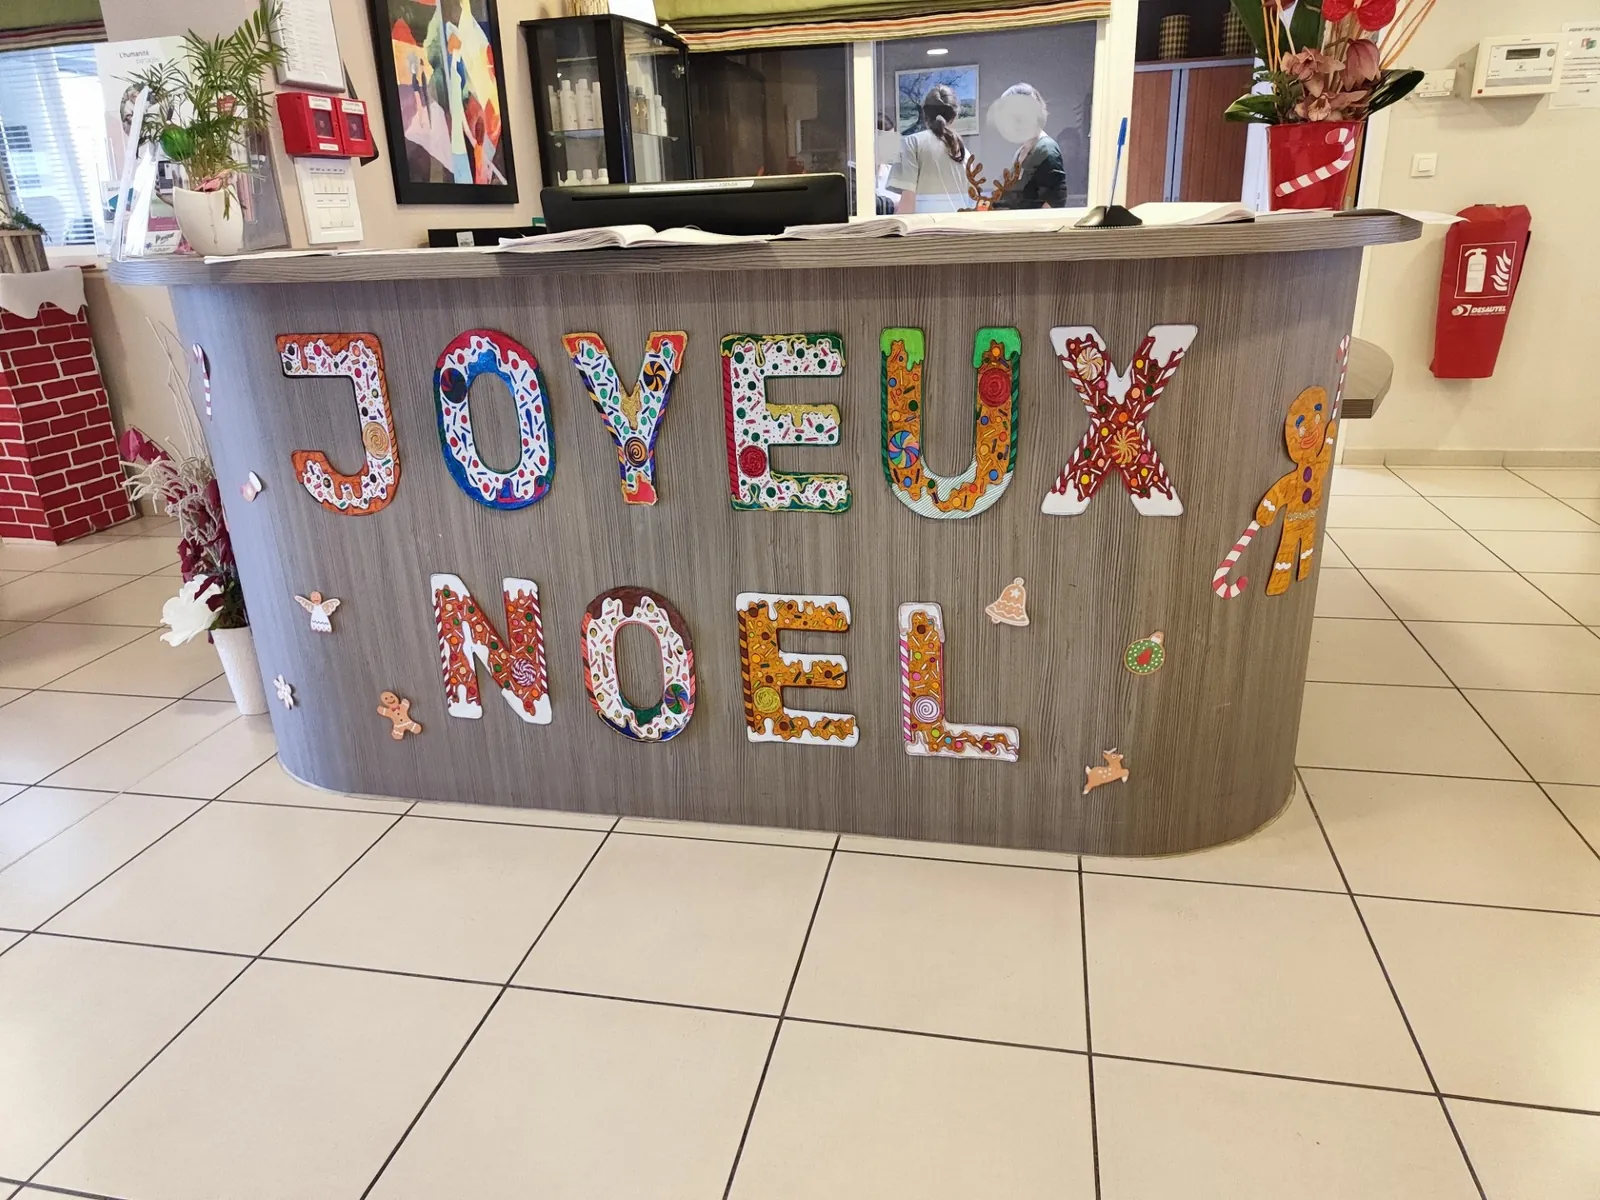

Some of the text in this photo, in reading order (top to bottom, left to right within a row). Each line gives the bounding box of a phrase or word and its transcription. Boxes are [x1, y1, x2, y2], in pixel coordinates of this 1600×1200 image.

[119, 50, 149, 58] L'humanité
[276, 324, 1198, 520] JOYEUX
[430, 573, 1020, 762] NOEL
